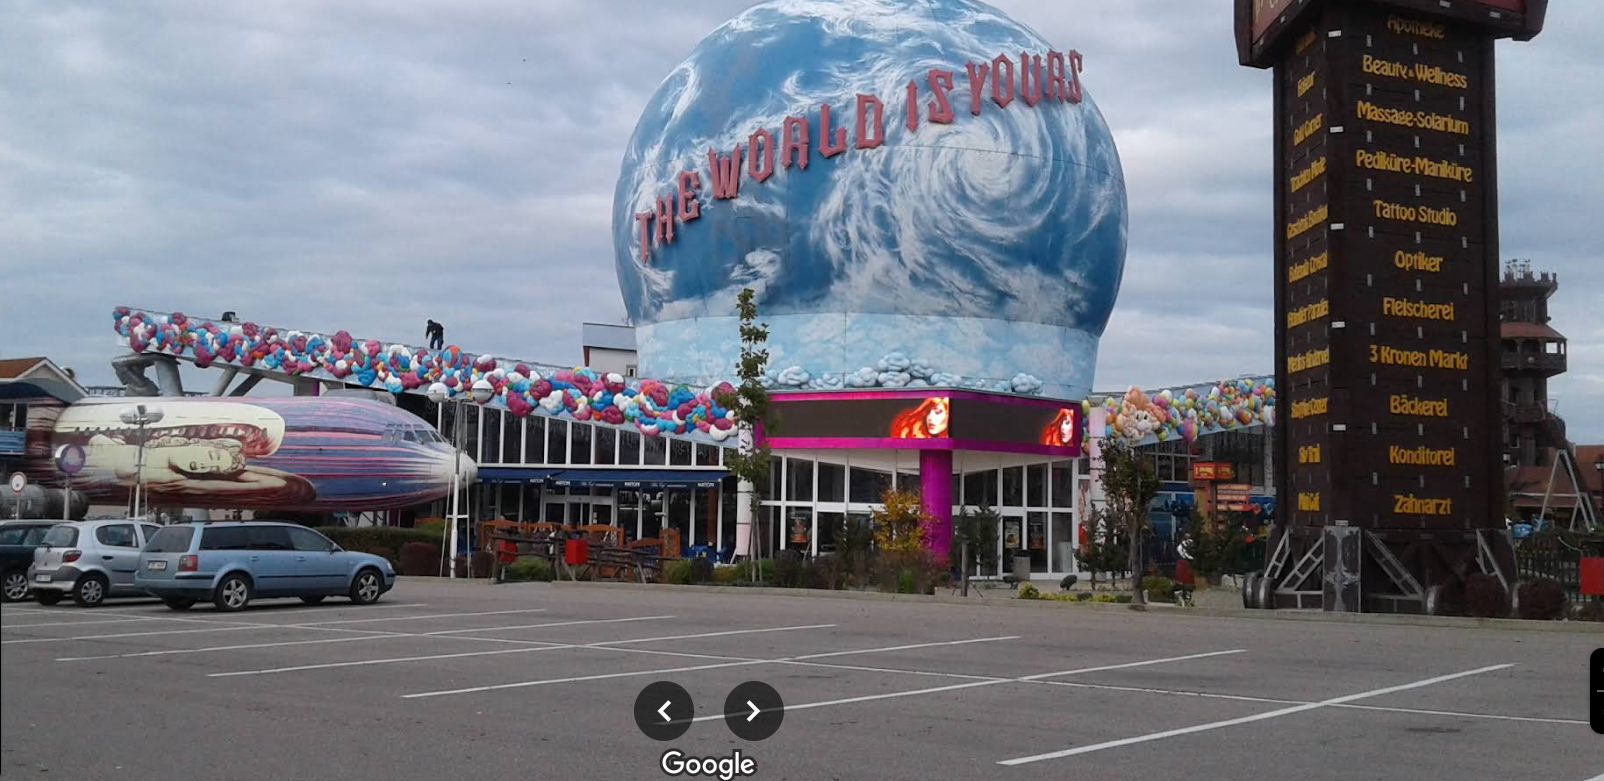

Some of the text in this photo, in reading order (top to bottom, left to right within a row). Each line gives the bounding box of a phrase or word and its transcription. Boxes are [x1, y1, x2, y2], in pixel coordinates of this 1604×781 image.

[1387, 15, 1445, 38] Apotheke
[1362, 54, 1407, 80] Beauty
[1415, 63, 1468, 89] Wellness
[1356, 100, 1469, 135] Massage-Solarium
[635, 49, 1084, 262] THE WORLD IS YOURS
[1355, 149, 1473, 183] Pediküre-Maniküre
[1373, 200, 1457, 226] Tattoo Studio
[1394, 250, 1443, 272] Optiker
[1383, 296, 1455, 321] Fleischerei
[1369, 344, 1468, 370] 3 Kronen Markt
[1389, 394, 1448, 417] Bäckerei
[1389, 444, 1455, 467] Konditorei
[1394, 494, 1453, 515] Zahnarzt
